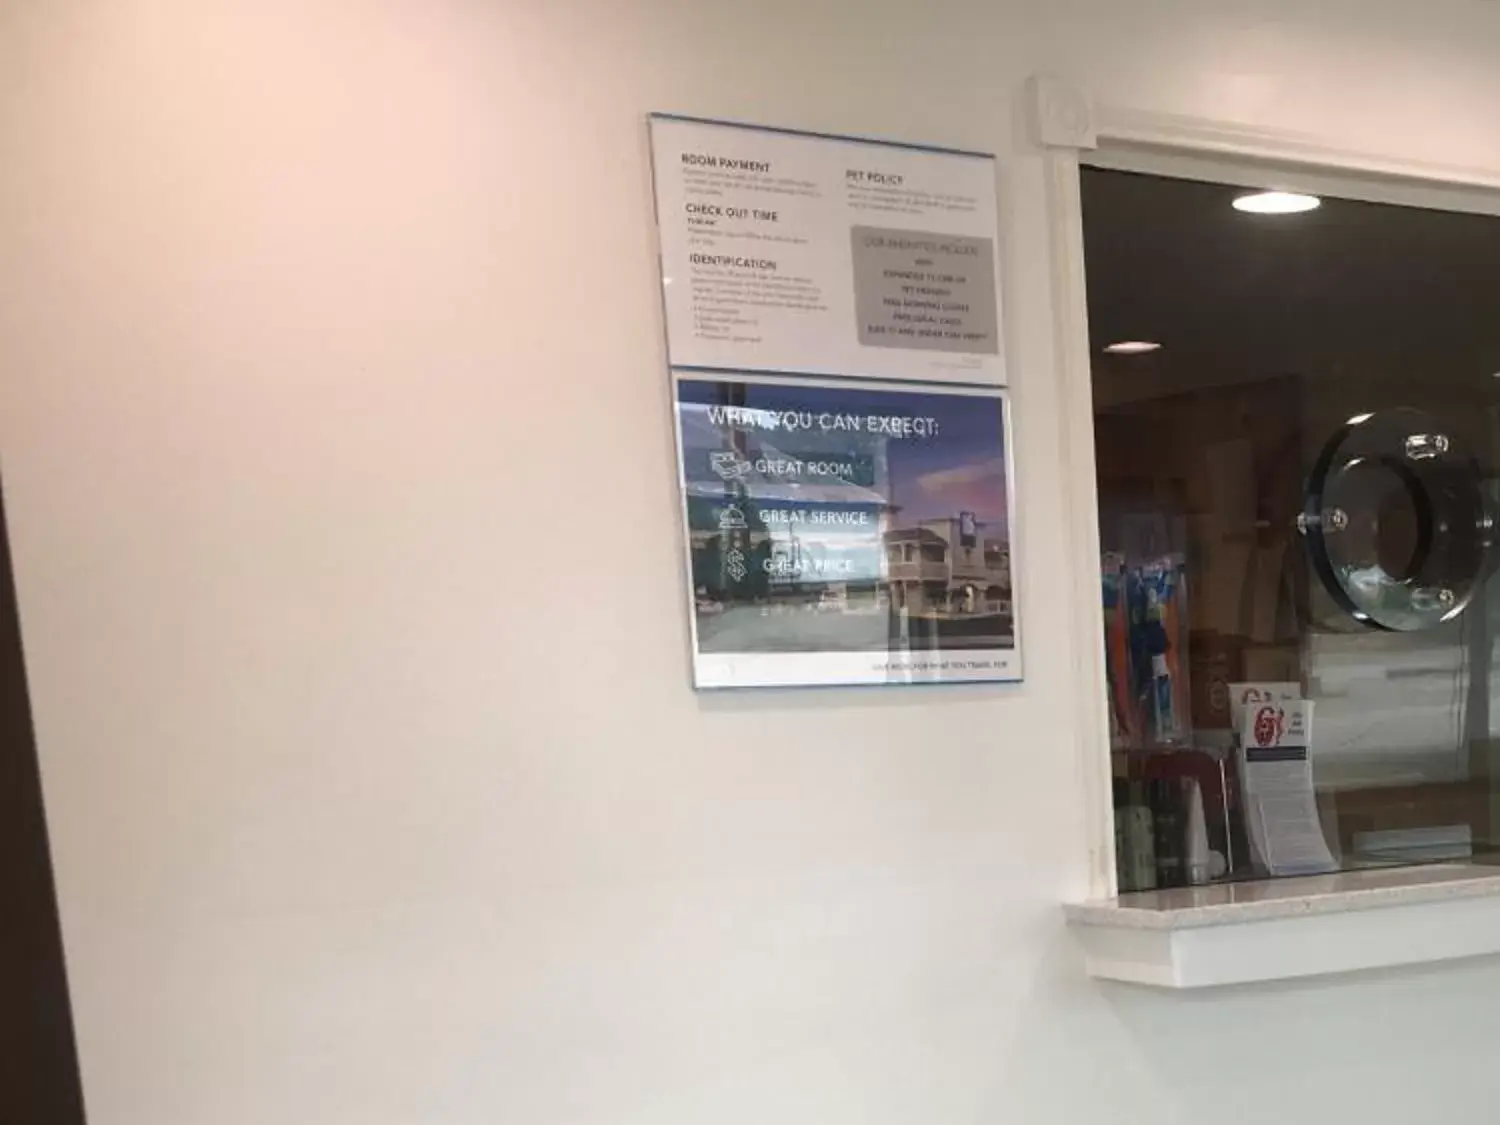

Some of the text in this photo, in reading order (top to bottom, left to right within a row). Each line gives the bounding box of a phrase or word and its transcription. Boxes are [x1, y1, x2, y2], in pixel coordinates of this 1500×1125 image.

[681, 153, 771, 173] ROOM PAYMENT
[846, 169, 903, 185] PET POLICY
[685, 203, 778, 222] CHECK OUT TIME
[689, 253, 777, 270] IDENTIFICATION
[774, 409, 814, 432] YOU
[819, 412, 860, 432] CAN
[755, 459, 853, 477] GREAT ROOM
[759, 508, 869, 526] GREAT SERVICE
[763, 557, 855, 574] GREAT PRICE
